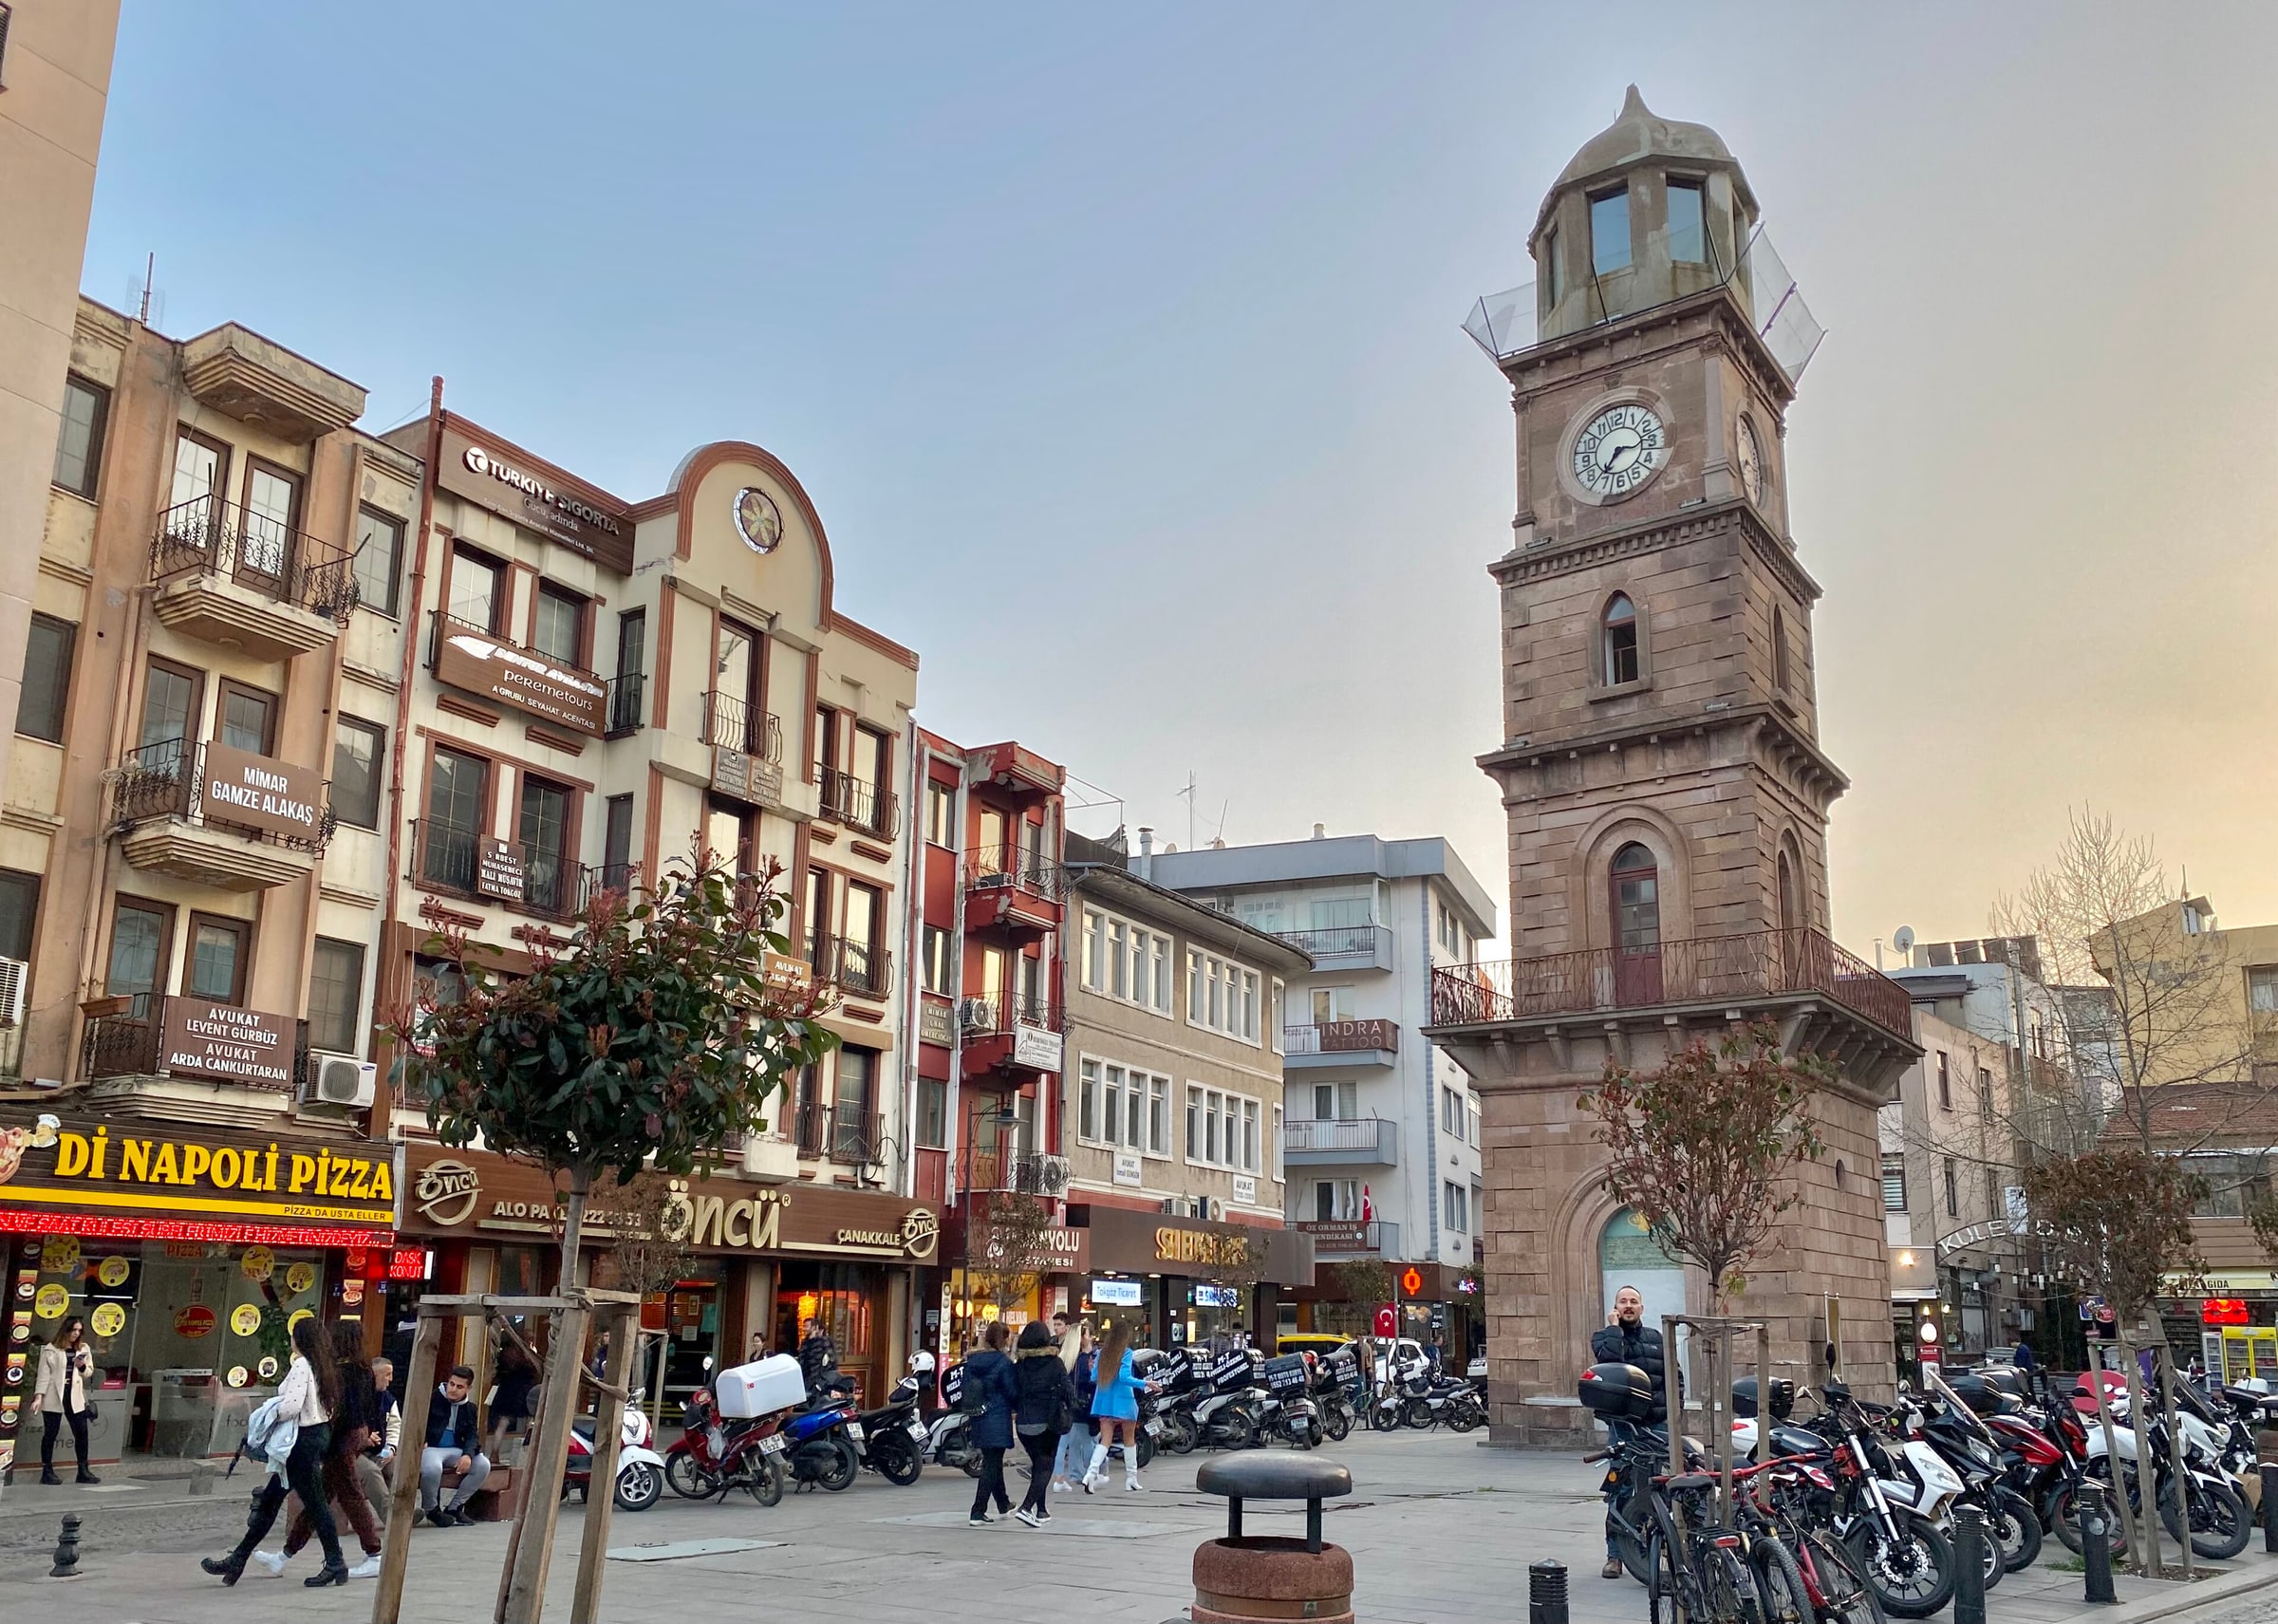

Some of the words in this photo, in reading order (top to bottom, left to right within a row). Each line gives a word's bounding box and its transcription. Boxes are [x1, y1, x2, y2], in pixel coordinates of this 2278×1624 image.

[1610, 413, 1623, 426] 12
[1630, 413, 1635, 425] 1
[1597, 422, 1608, 436] 11
[1642, 420, 1652, 433] 2
[1582, 438, 1596, 451] 10
[1648, 435, 1657, 447] 3
[1581, 455, 1591, 467] 9
[1644, 452, 1653, 464] 4
[1586, 469, 1596, 482] 8
[1632, 467, 1641, 479] 5
[1601, 476, 1611, 490] 7
[1616, 475, 1625, 488] 6
[527, 698, 560, 717] SEYAHAT
[243, 766, 289, 794] MİMAR
[211, 780, 261, 811] GAMZE
[262, 793, 315, 827] ALAKAŞ
[487, 851, 516, 865] SRBEST
[775, 961, 804, 976] AVUKAT
[209, 1008, 260, 1027] AVUKAT
[186, 1018, 229, 1038] LEVENT
[231, 1021, 278, 1045] GÜRBÜZ
[1322, 1020, 1382, 1036] INDRA
[1323, 1036, 1382, 1049] TATTOO
[205, 1042, 257, 1062] AVUKAT
[170, 1051, 203, 1069] ARDA
[205, 1056, 288, 1081] CANKURTARAN
[54, 1126, 106, 1178] Dİ
[120, 1142, 277, 1190] NAPOLİ
[288, 1148, 393, 1200] PİZZA
[330, 1210, 354, 1219] USTA
[356, 1212, 385, 1221] ELLER
[493, 1202, 526, 1218] ALO
[661, 1180, 780, 1249] öncü
[838, 1228, 901, 1246] ÇANAKKALE
[1939, 1220, 2006, 1255] KULE
[166, 1245, 203, 1258] PIZZA
[395, 1251, 421, 1264] DASK
[390, 1265, 423, 1279] KONUT
[2207, 1279, 2230, 1289] GIDA
[1118, 1287, 1137, 1299] Ticaret
[760, 1438, 768, 1448] 17
